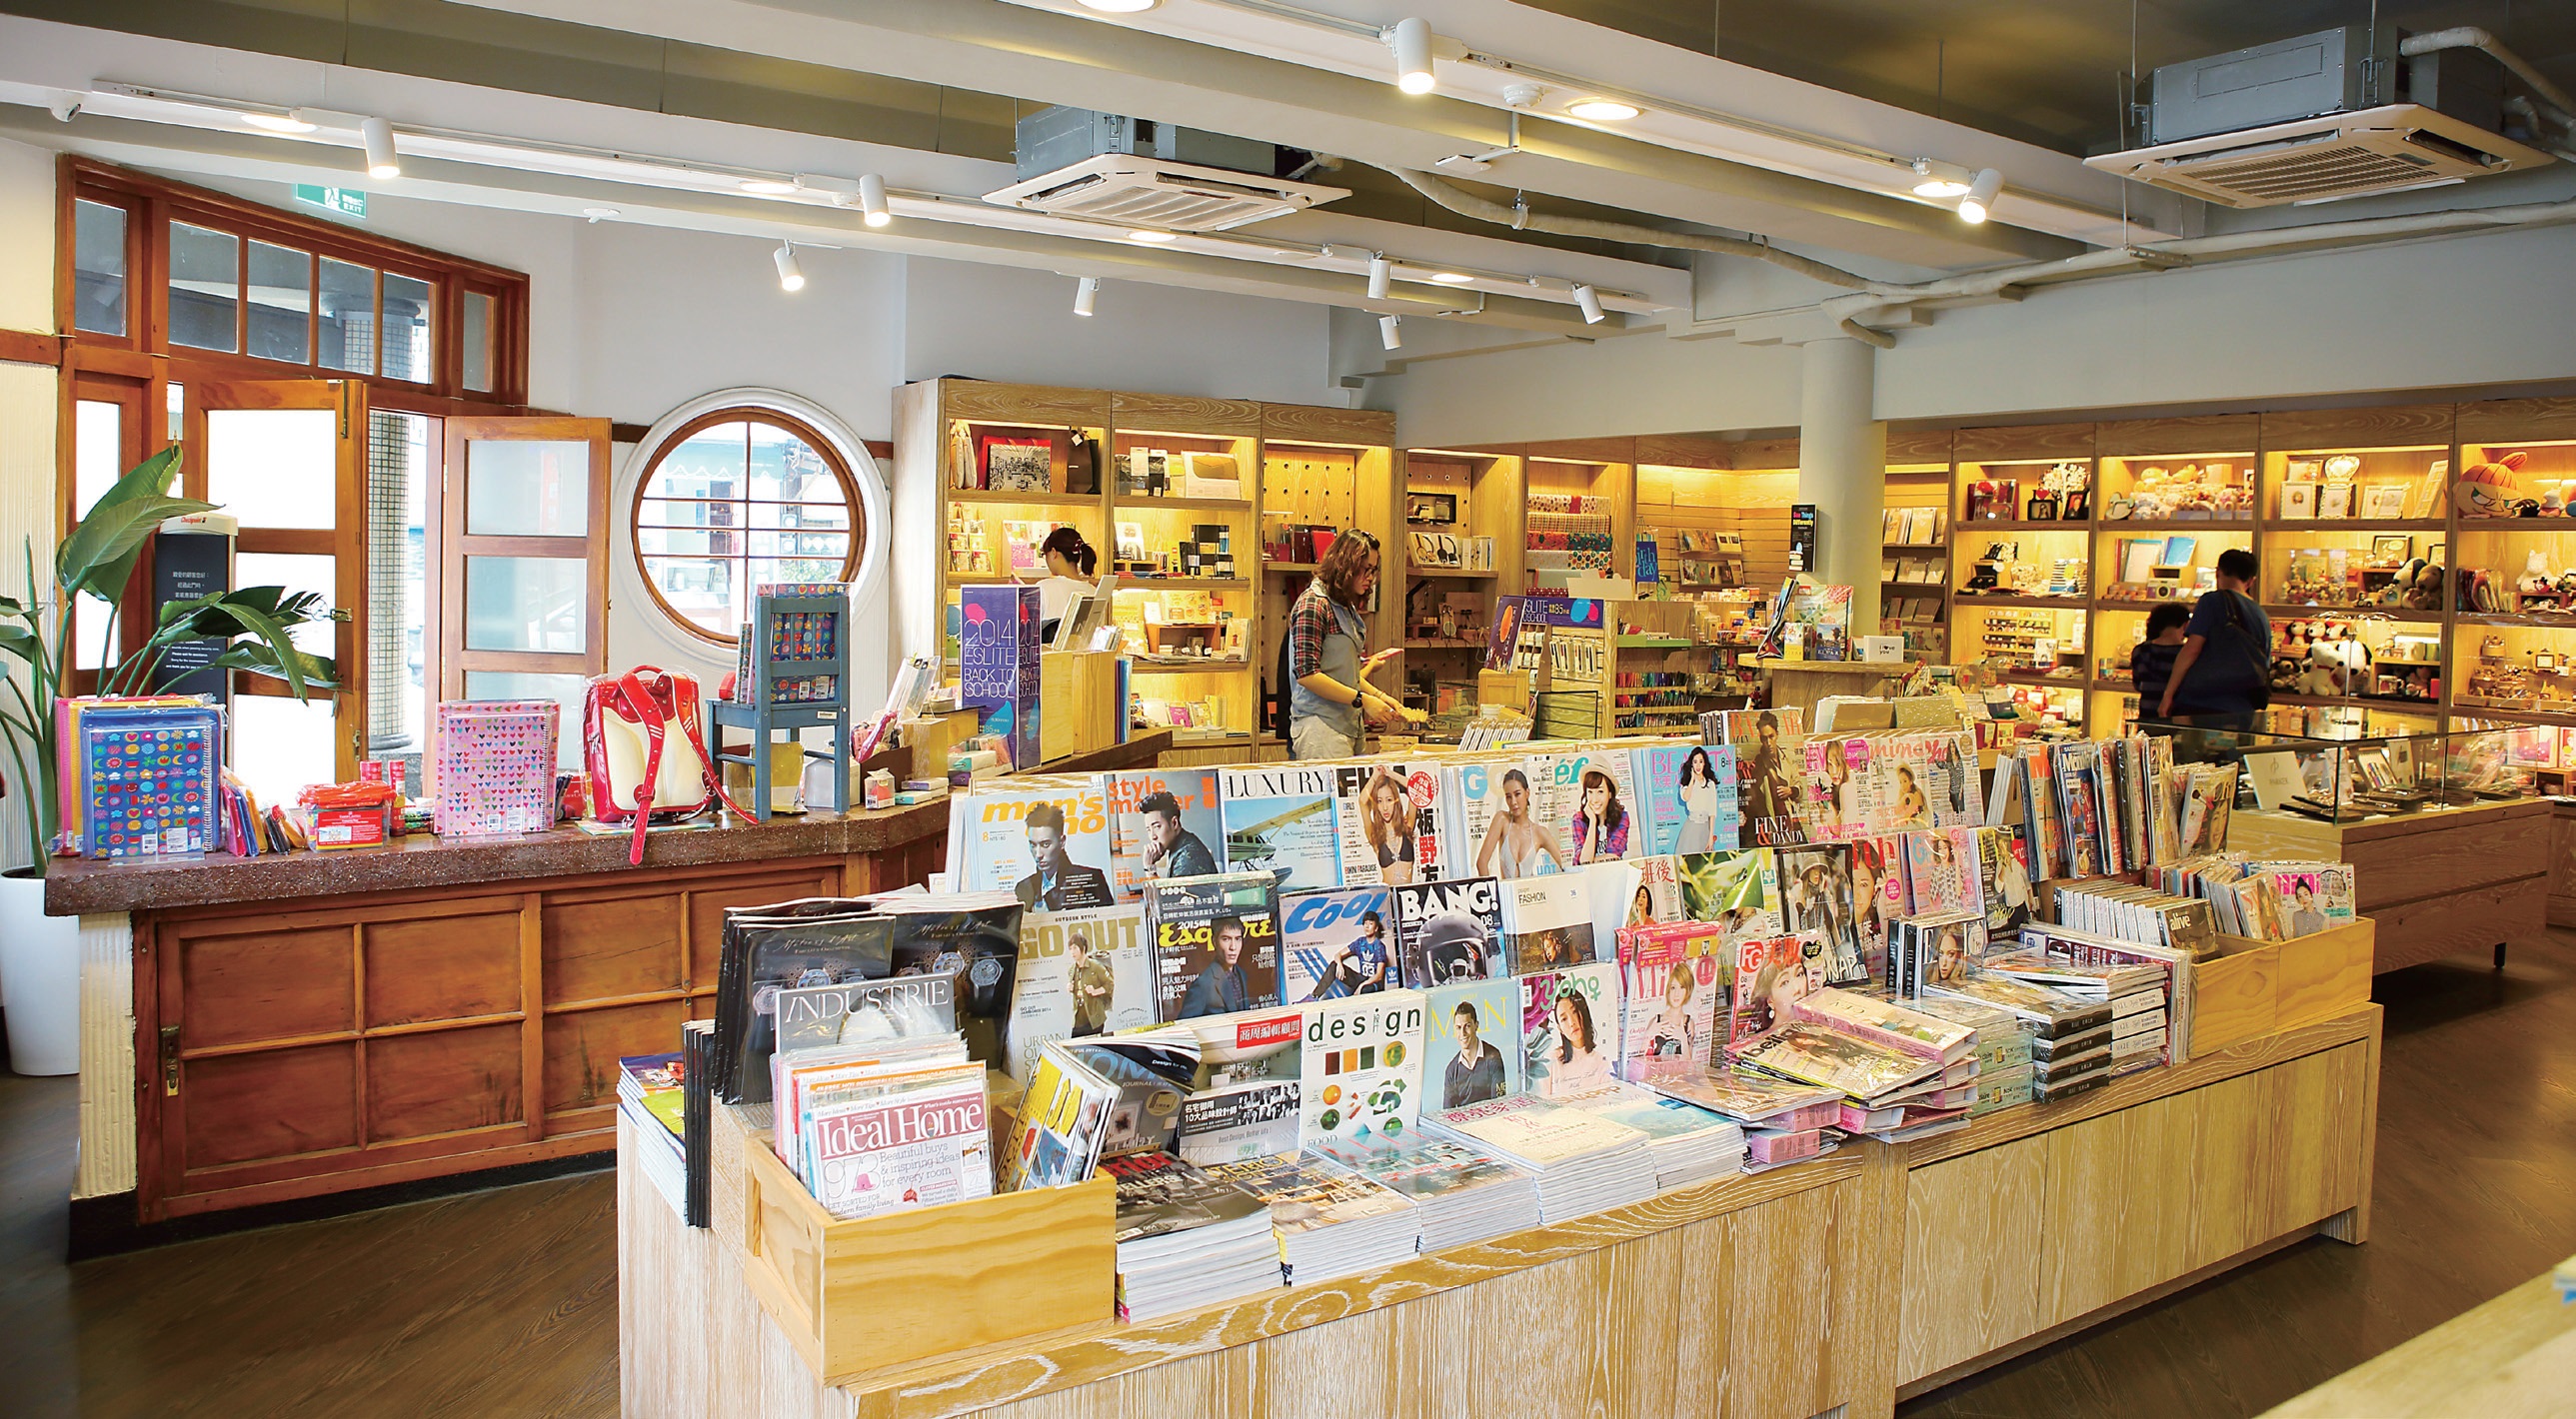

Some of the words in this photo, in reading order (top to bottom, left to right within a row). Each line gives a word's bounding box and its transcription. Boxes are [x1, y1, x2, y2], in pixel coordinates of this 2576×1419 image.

[1525, 600, 1548, 614] SLITE
[964, 619, 1015, 647] 2014
[964, 648, 1015, 666] ESLITE
[964, 669, 996, 682] BACK
[999, 669, 1016, 682] TO
[964, 682, 1015, 699] SCHOOL
[1651, 747, 1735, 776] BETY
[1108, 774, 1167, 800] style
[1229, 770, 1330, 798] LUXURY
[1754, 814, 1790, 835] FINE
[1772, 829, 1804, 845] DANDY
[1398, 880, 1499, 922] BANG!
[1518, 891, 1546, 904] FASHION
[2169, 912, 2192, 932] alive
[1020, 924, 1065, 960] GO
[1068, 916, 1142, 953] OUT
[1740, 944, 1763, 970] FG
[785, 979, 951, 1024] INDUSTRIE
[1428, 996, 1507, 1042] MN
[818, 1109, 893, 1159] Ideal
[896, 1102, 984, 1144] Home
[1306, 1134, 1338, 1147] FOOD
[880, 1146, 926, 1162] Beautiful
[925, 1142, 949, 1156] buys
[881, 1165, 890, 1175] &
[890, 1157, 934, 1175] inspiring
[934, 1152, 961, 1167] ideas
[882, 1176, 895, 1189] for
[899, 1171, 926, 1186] every
[926, 1166, 953, 1179] room
[842, 1196, 867, 1209] SORTED
[868, 1193, 881, 1203] FOR
[855, 1200, 877, 1215] family
[876, 1197, 895, 1212] living
